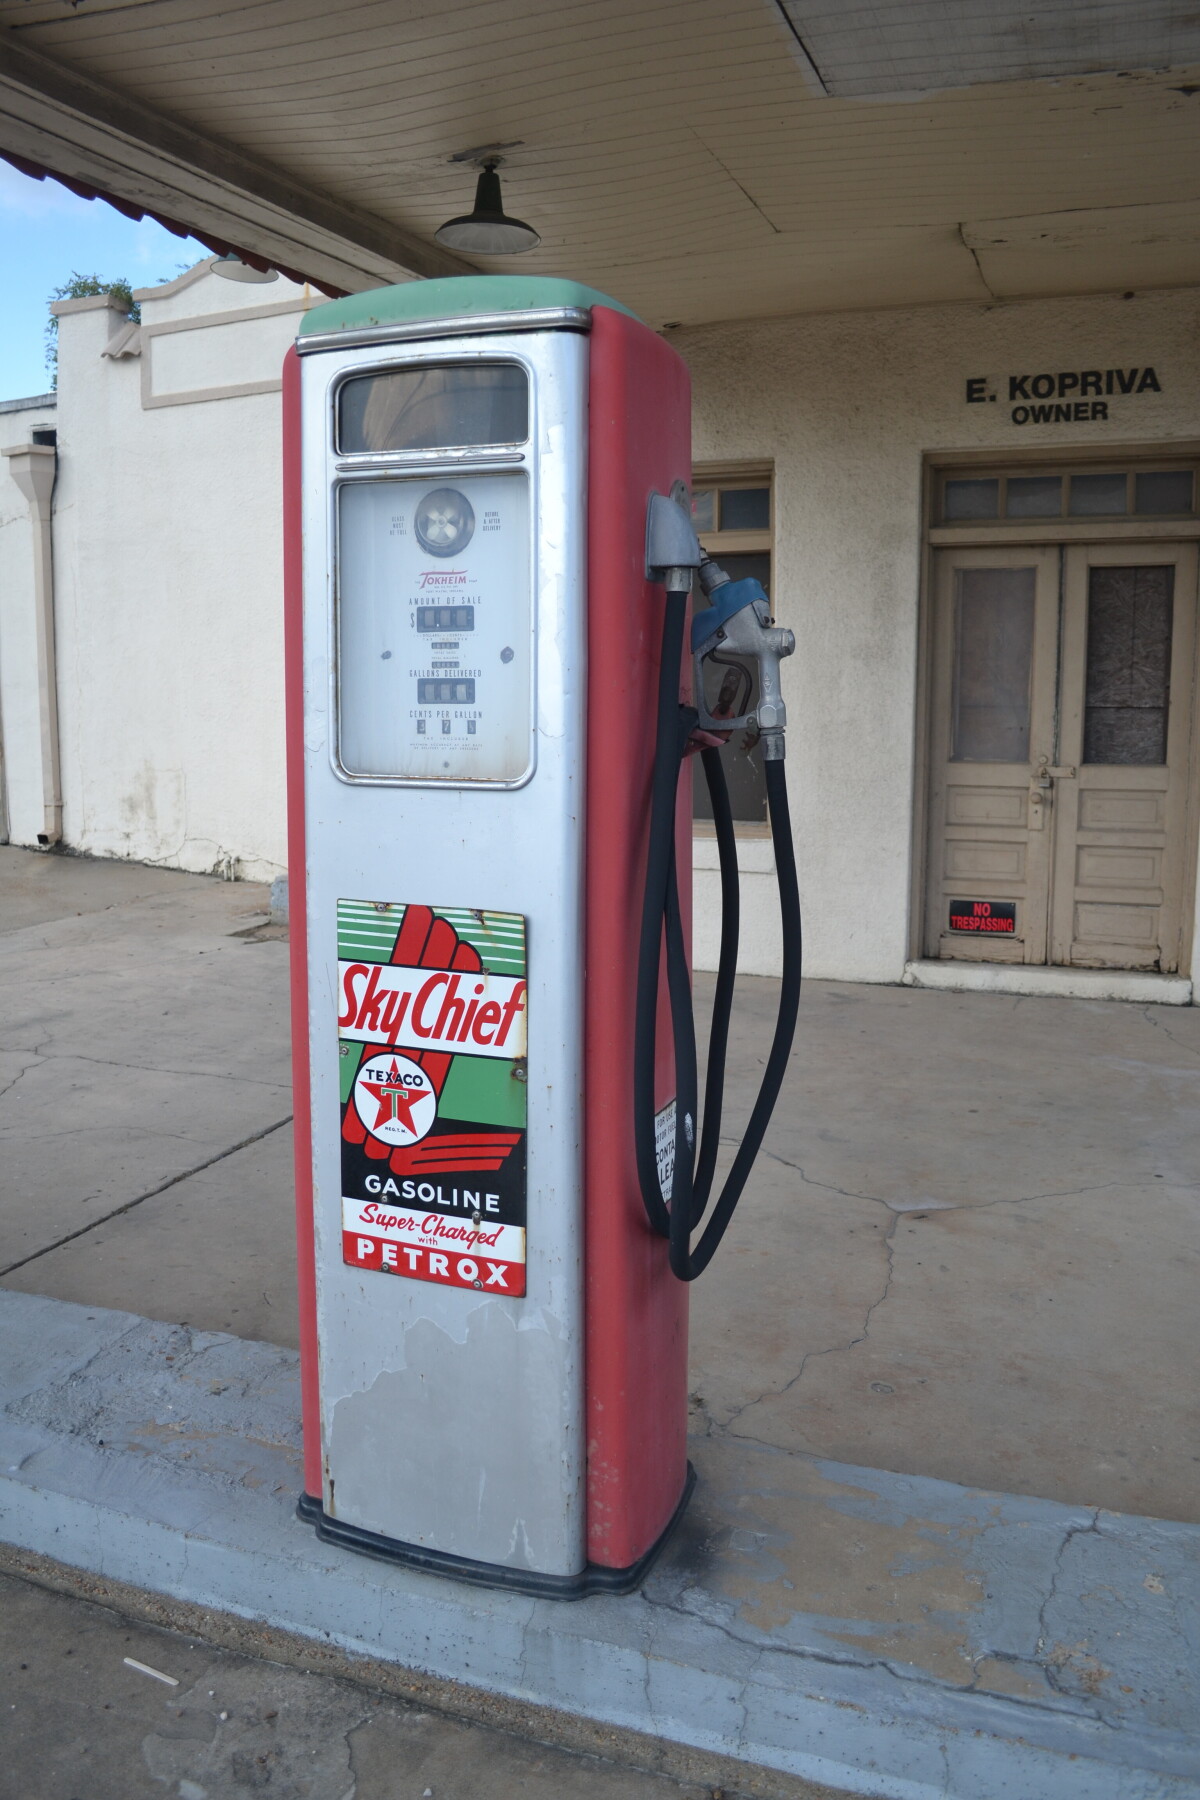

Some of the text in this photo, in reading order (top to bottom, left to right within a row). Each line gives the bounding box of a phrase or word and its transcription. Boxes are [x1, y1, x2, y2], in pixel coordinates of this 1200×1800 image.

[966, 367, 1162, 403] E. KOPRIVA
[1011, 402, 1108, 425] OWNER
[418, 570, 468, 590] TOKHEIM
[408, 597, 440, 606] AMOUNT
[461, 596, 482, 604] SALE
[409, 670, 482, 678] GALLONS DELIVERED
[409, 710, 482, 718] CENTS PER GALLON
[973, 902, 991, 916] NO
[950, 916, 1014, 932] TRESPASSING
[338, 964, 526, 1047] Sky Chief
[366, 1068, 424, 1088] TEXACO
[381, 1088, 408, 1118] T
[656, 1138, 676, 1164] CONTA
[660, 1157, 674, 1186] LEA
[365, 1174, 500, 1212] GASOLINE
[358, 1203, 504, 1250] Super-Charged
[418, 1235, 438, 1246] with
[357, 1237, 508, 1288] PETROX
